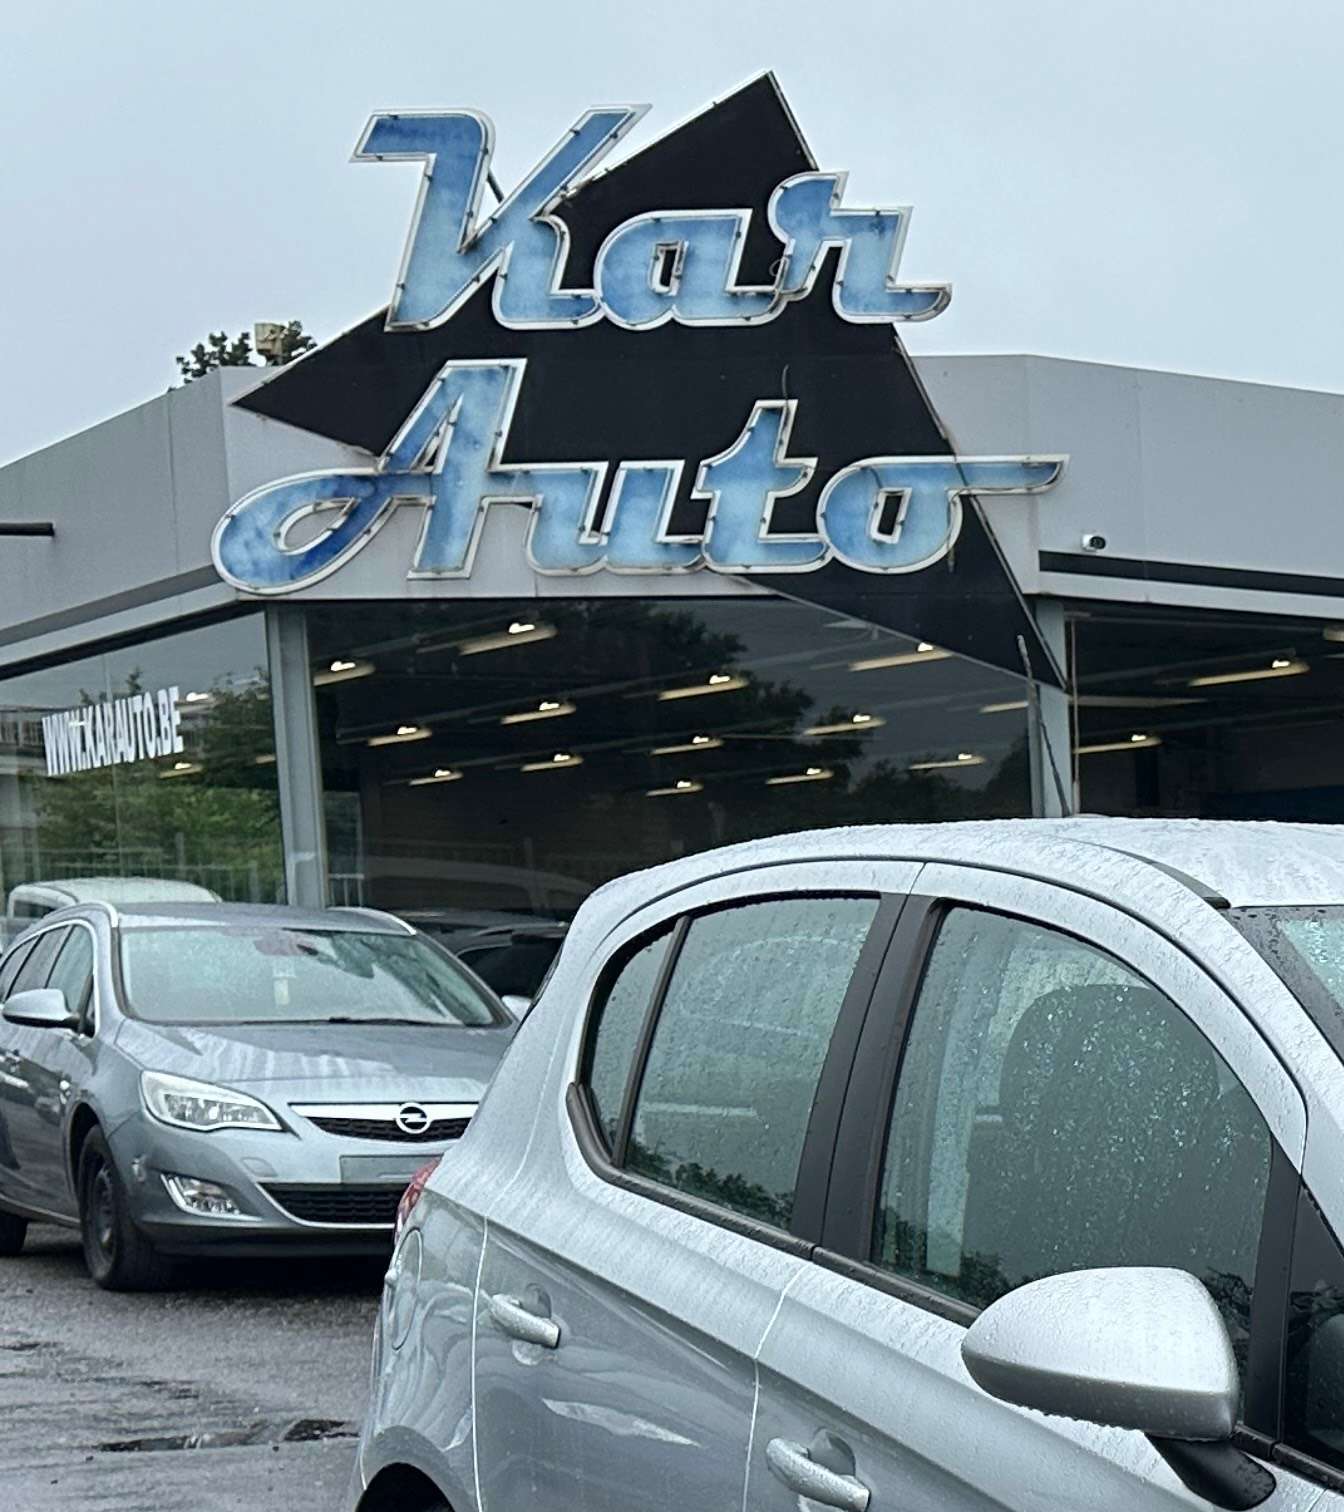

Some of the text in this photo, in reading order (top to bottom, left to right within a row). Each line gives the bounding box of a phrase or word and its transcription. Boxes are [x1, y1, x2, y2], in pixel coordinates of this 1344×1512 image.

[348, 103, 953, 332] Kar
[210, 357, 1068, 596] Auto
[41, 685, 185, 777] WWW.KARAUTO.BE
